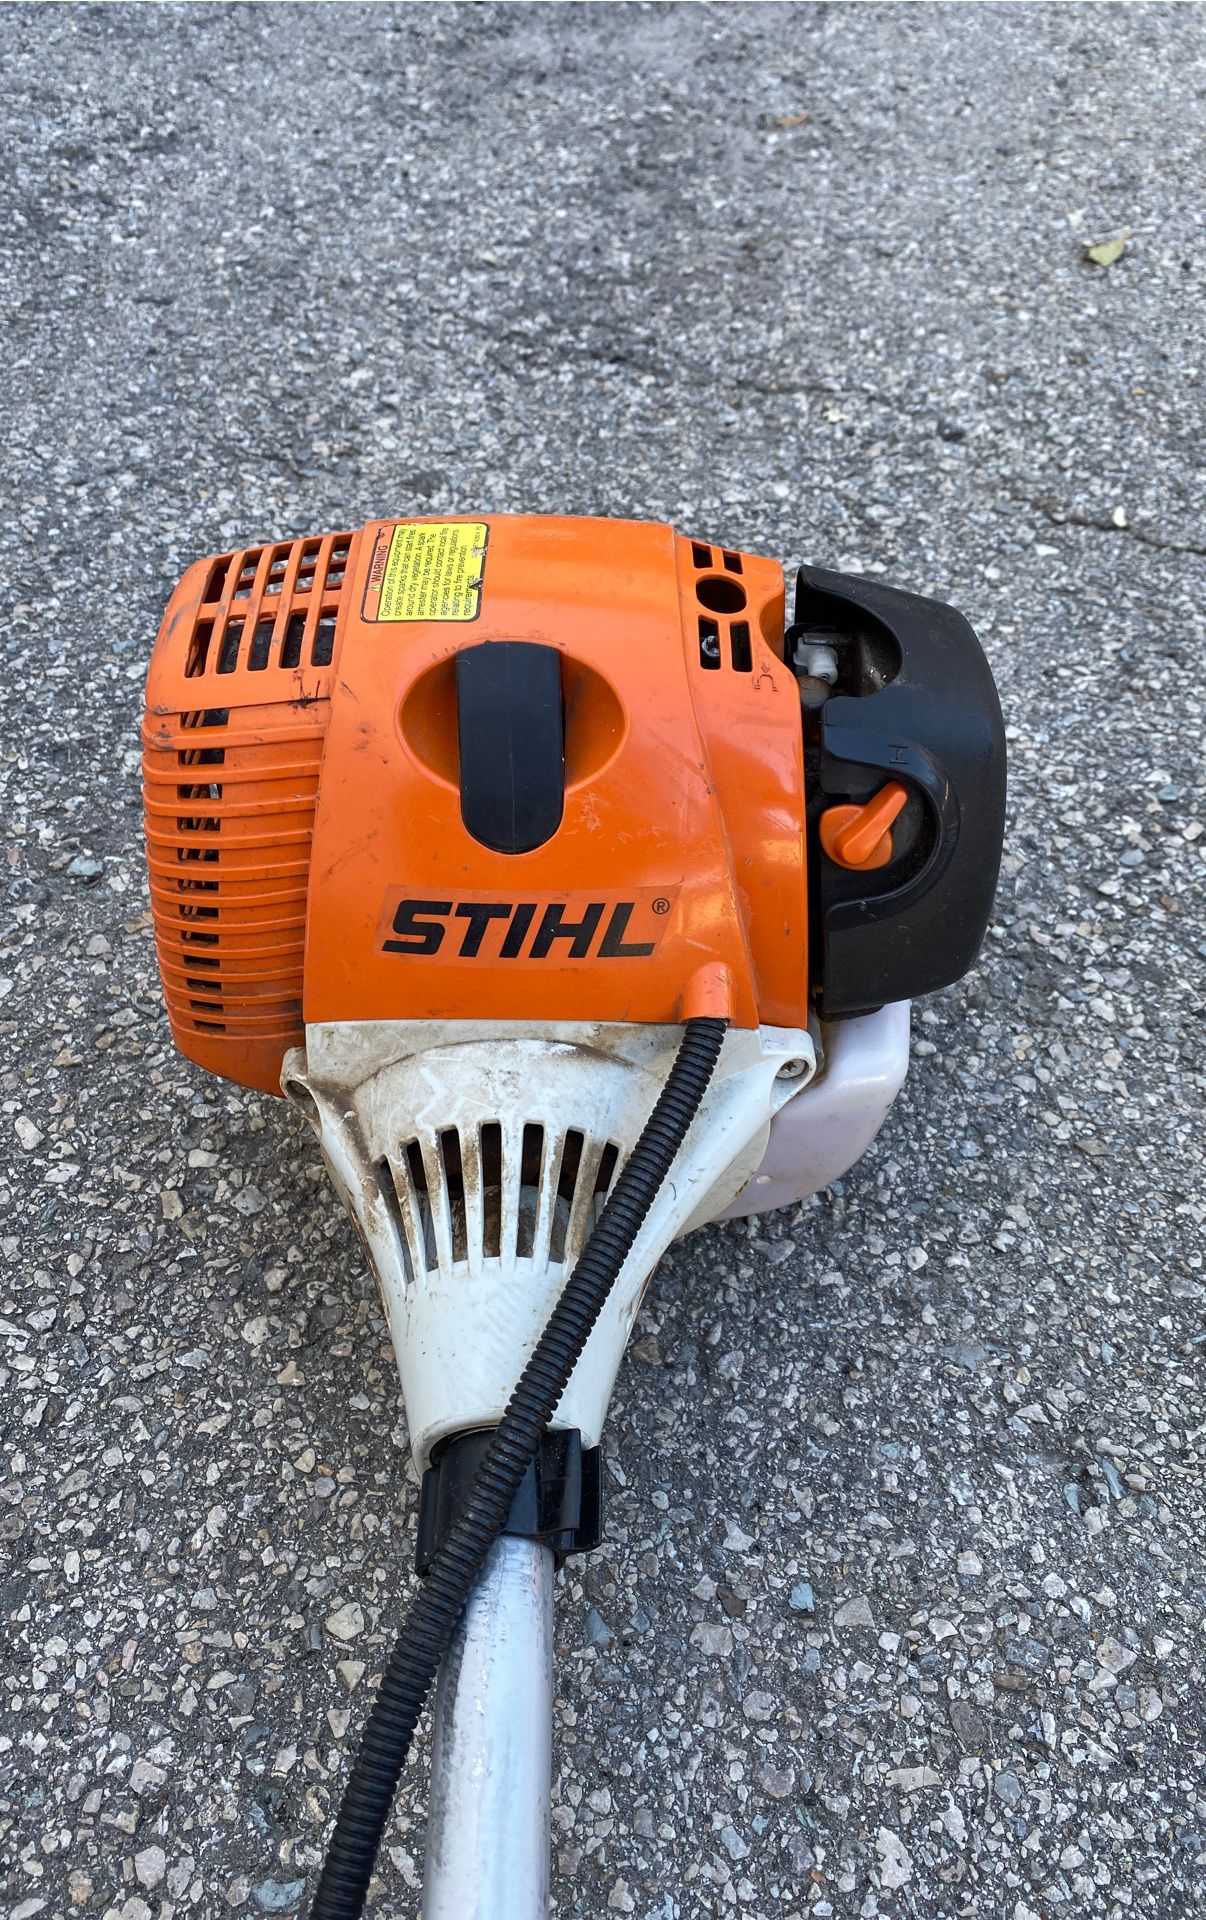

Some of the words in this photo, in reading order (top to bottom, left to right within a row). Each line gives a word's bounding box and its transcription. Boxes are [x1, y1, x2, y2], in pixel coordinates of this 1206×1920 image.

[399, 528, 407, 538] may
[406, 530, 416, 539] fires
[417, 533, 426, 545] spark
[438, 536, 447, 547] local
[448, 530, 459, 555] regulations
[391, 539, 403, 566] equipment
[405, 540, 413, 551] start
[371, 545, 387, 582] WARNING
[402, 552, 411, 562] can
[434, 548, 444, 567] contact
[457, 546, 467, 573] prevention
[389, 567, 397, 577] this
[401, 563, 409, 574] that
[417, 591, 425, 615] arrester
[421, 577, 430, 590] may
[427, 534, 436, 543] The
[431, 569, 442, 587] should
[444, 564, 454, 577] laws
[398, 575, 407, 594] sparks
[409, 583, 418, 592] dry
[455, 575, 463, 583] fire
[381, 585, 394, 616] Operation
[395, 596, 403, 616] create
[406, 594, 415, 616] around
[429, 589, 438, 615] operator
[441, 587, 451, 615] agencies
[452, 592, 463, 615] relating
[381, 899, 656, 958] STIHL
